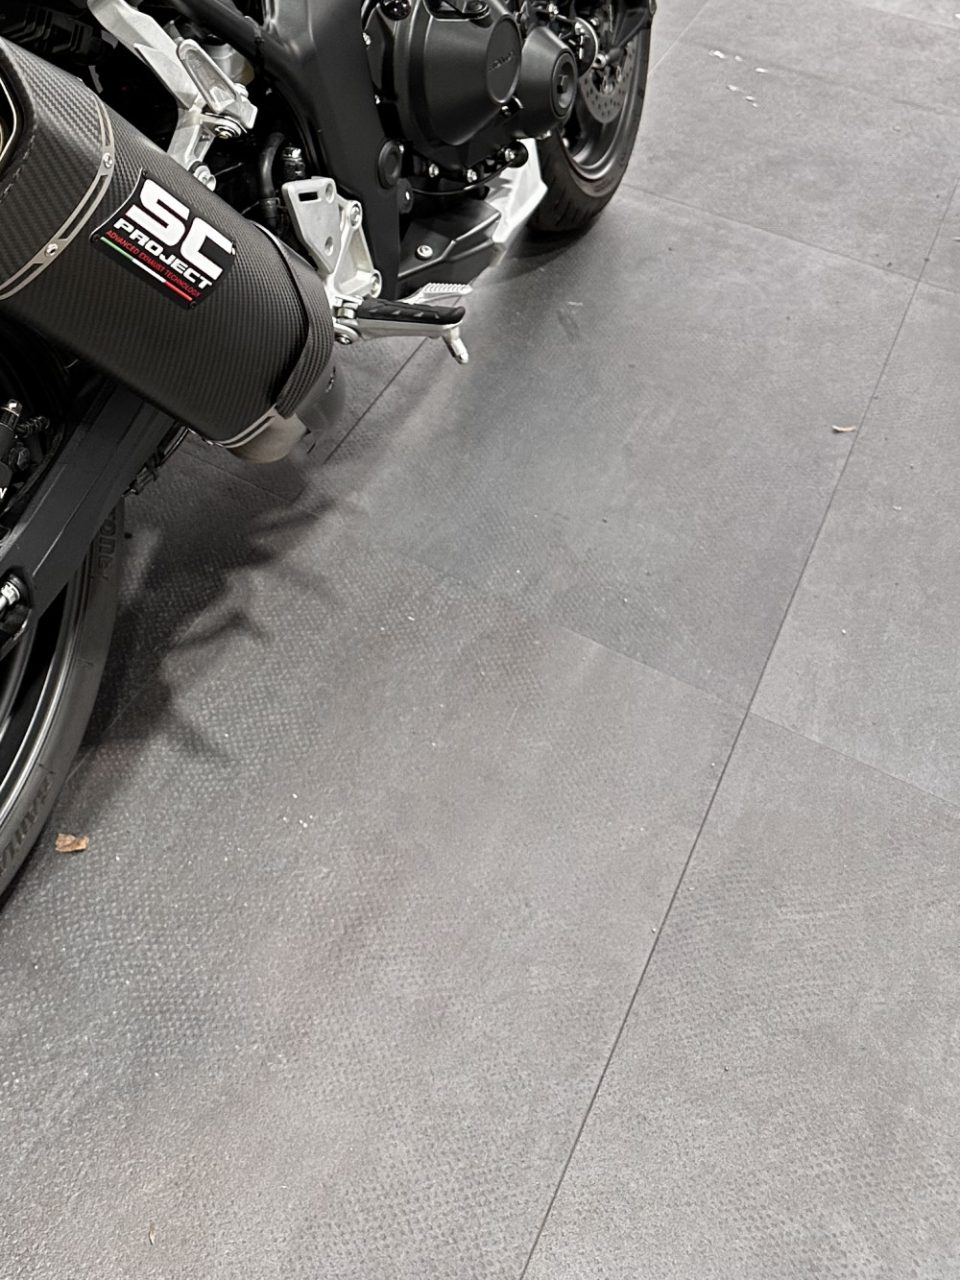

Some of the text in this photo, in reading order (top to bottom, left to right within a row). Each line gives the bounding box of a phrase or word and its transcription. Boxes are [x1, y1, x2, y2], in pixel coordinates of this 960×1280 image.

[105, 229, 141, 255] ADVANCED
[162, 267, 202, 298] TECHNOLOGY
[113, 218, 213, 289] PROJECT
[125, 178, 236, 281] SC
